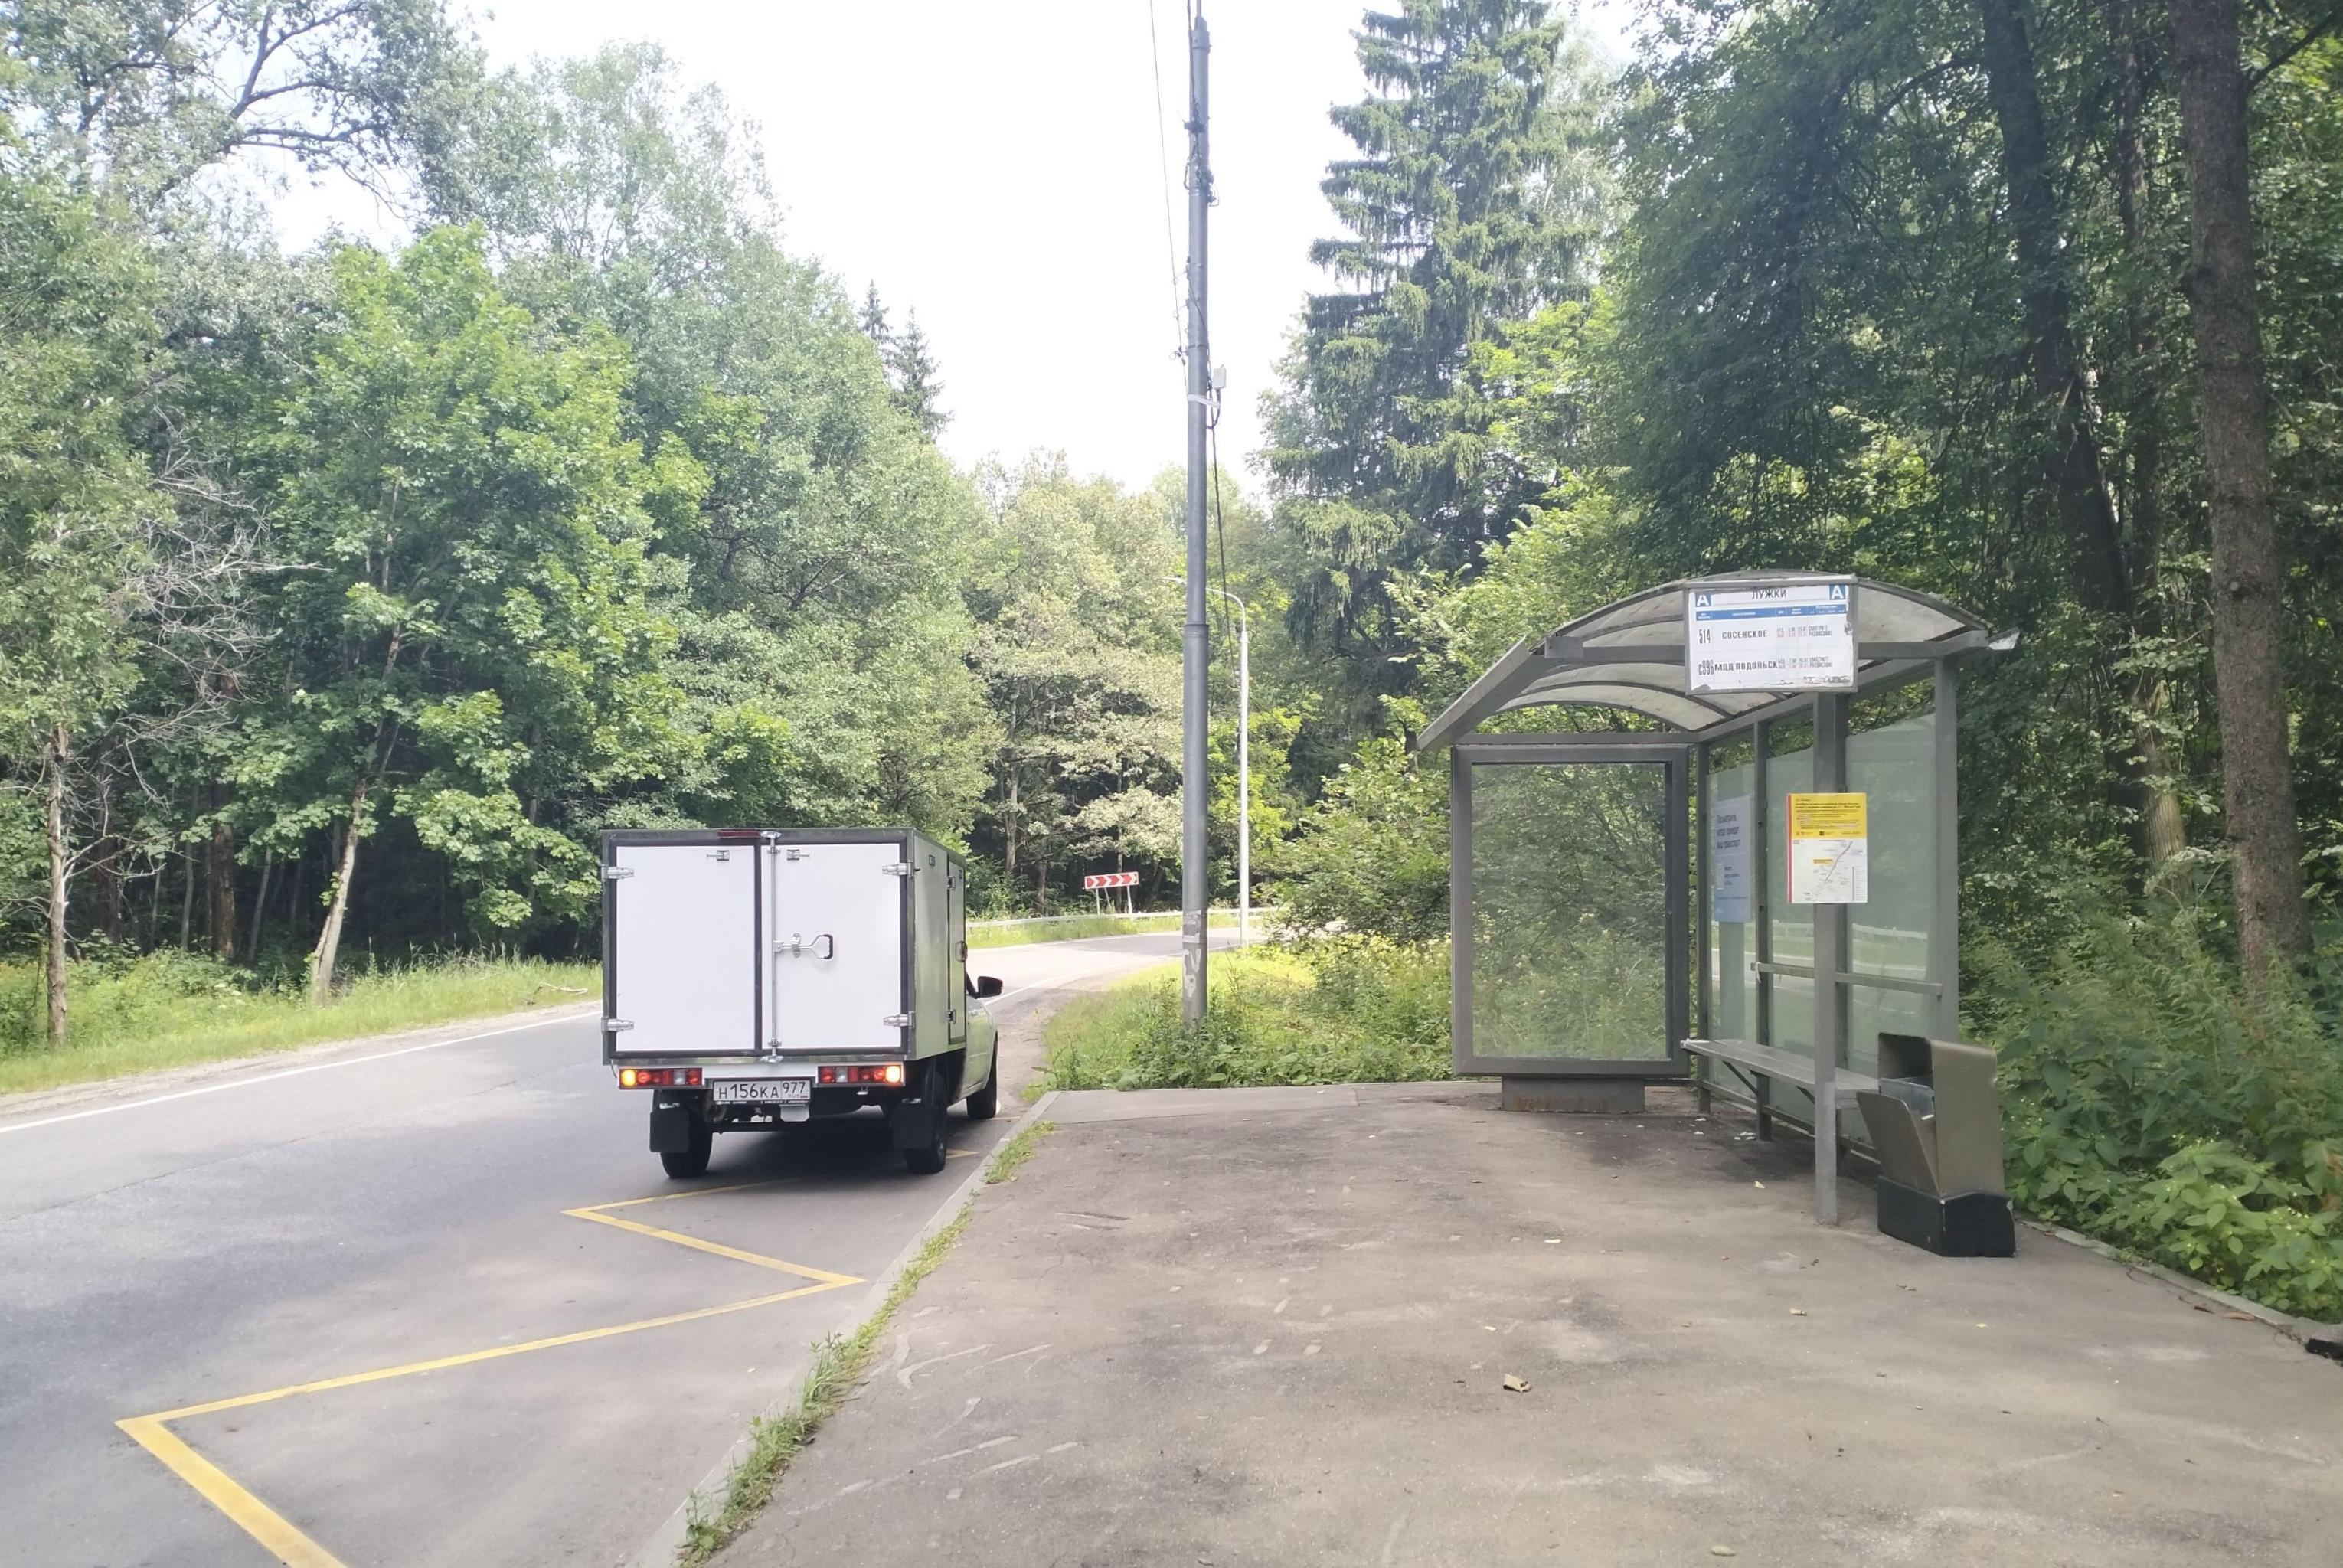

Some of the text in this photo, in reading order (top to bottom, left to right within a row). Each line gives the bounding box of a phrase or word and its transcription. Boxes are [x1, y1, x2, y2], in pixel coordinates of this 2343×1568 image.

[1752, 589, 1787, 600] ЛУЖКИ
[1699, 629, 1711, 645] 514
[1722, 629, 1767, 640] СОСЕНСКОЕ
[1736, 662, 1778, 671] ПОДОЛЬСК
